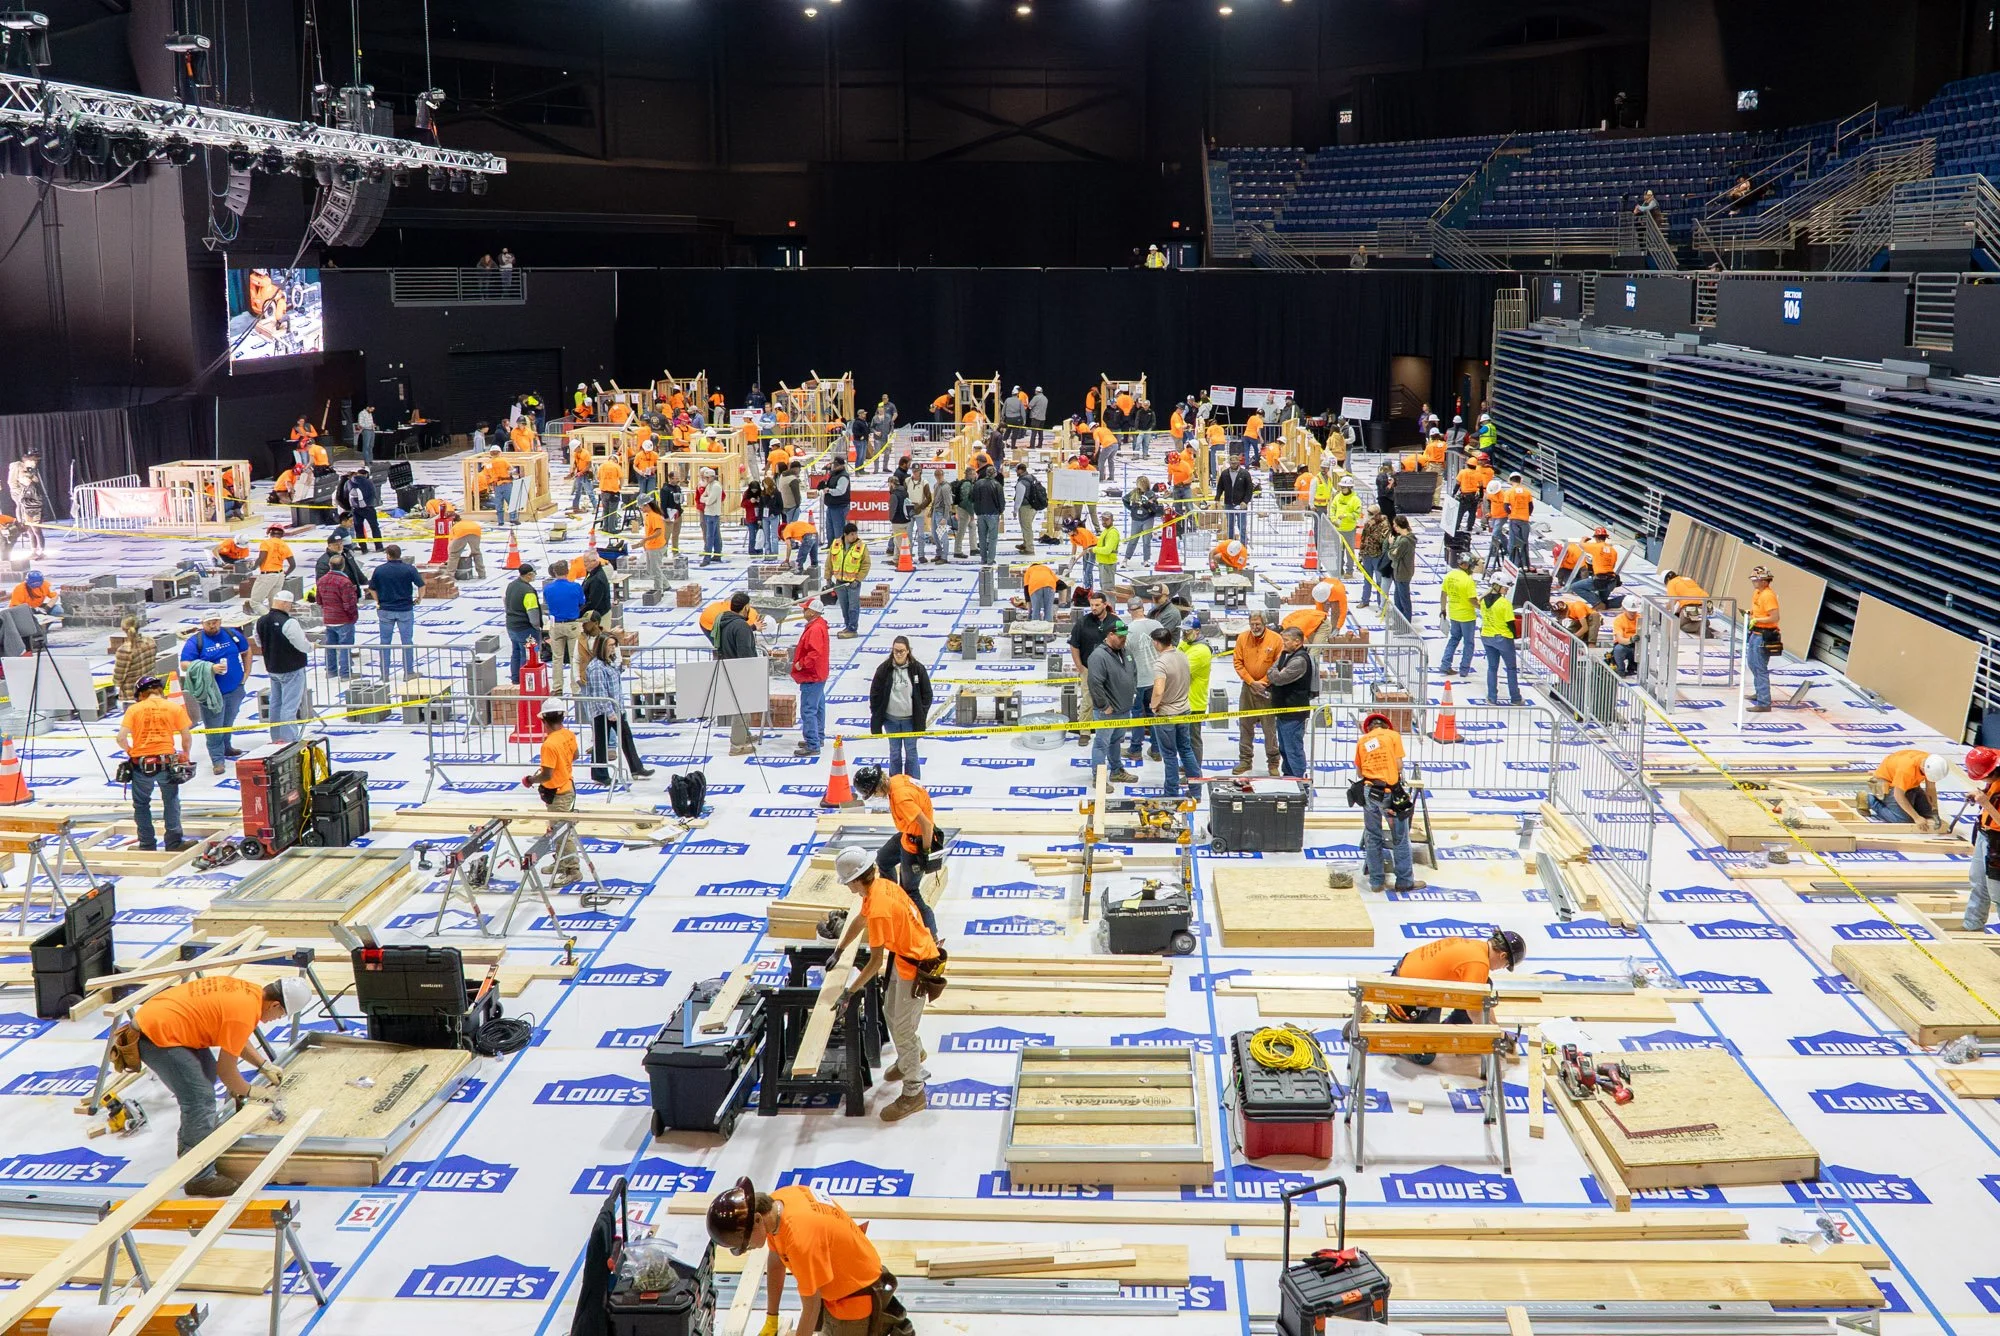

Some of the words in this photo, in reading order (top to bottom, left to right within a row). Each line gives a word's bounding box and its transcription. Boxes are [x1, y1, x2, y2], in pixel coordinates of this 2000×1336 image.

[1784, 300, 1800, 319] 106
[850, 501, 889, 511] PLUMB
[1017, 787, 1082, 795] LOWE'S
[758, 809, 823, 817] LOWE'S
[953, 846, 997, 856] WE'S
[1312, 849, 1366, 859] LOWE
[1440, 849, 1518, 859] LOWE'S
[170, 876, 236, 888] LOWE'S
[712, 886, 782, 896] LOWE'S
[982, 888, 1063, 899] LOWE'S
[1397, 892, 1472, 901] LOWE'S
[1669, 892, 1746, 902] LOWE'S
[118, 911, 195, 924] LOWE'S
[542, 918, 620, 931] LOWE'S
[686, 920, 764, 931] LOWE'S
[976, 922, 1057, 934] LOWE'S
[1412, 926, 1491, 937] LOWE'S
[1556, 926, 1640, 937] LOWE'S
[1700, 927, 1783, 938] LOWE'S
[757, 961, 777, 970] 16
[1686, 979, 1757, 992] OWE'S
[952, 1037, 1044, 1052] LOWE'S
[1804, 1040, 1899, 1055] LOWE'S
[20, 1077, 96, 1094] LOWE
[374, 1068, 416, 1114] AdvanTech
[549, 1086, 649, 1103] LOWE'S
[931, 1092, 1011, 1107] OWE'S
[1828, 1094, 1930, 1111] LOWE'S
[1, 1159, 110, 1181] LOWE'S
[389, 1168, 502, 1188] LOWE'S
[794, 1174, 897, 1195] LOWE'S
[991, 1178, 1099, 1197] LOWES
[1196, 1180, 1300, 1199] LOWE'S
[1399, 1179, 1506, 1200] LOWE'S
[1803, 1181, 1912, 1200] LOWE'S
[348, 1206, 377, 1222] 13
[413, 1273, 535, 1297] LOWE'S
